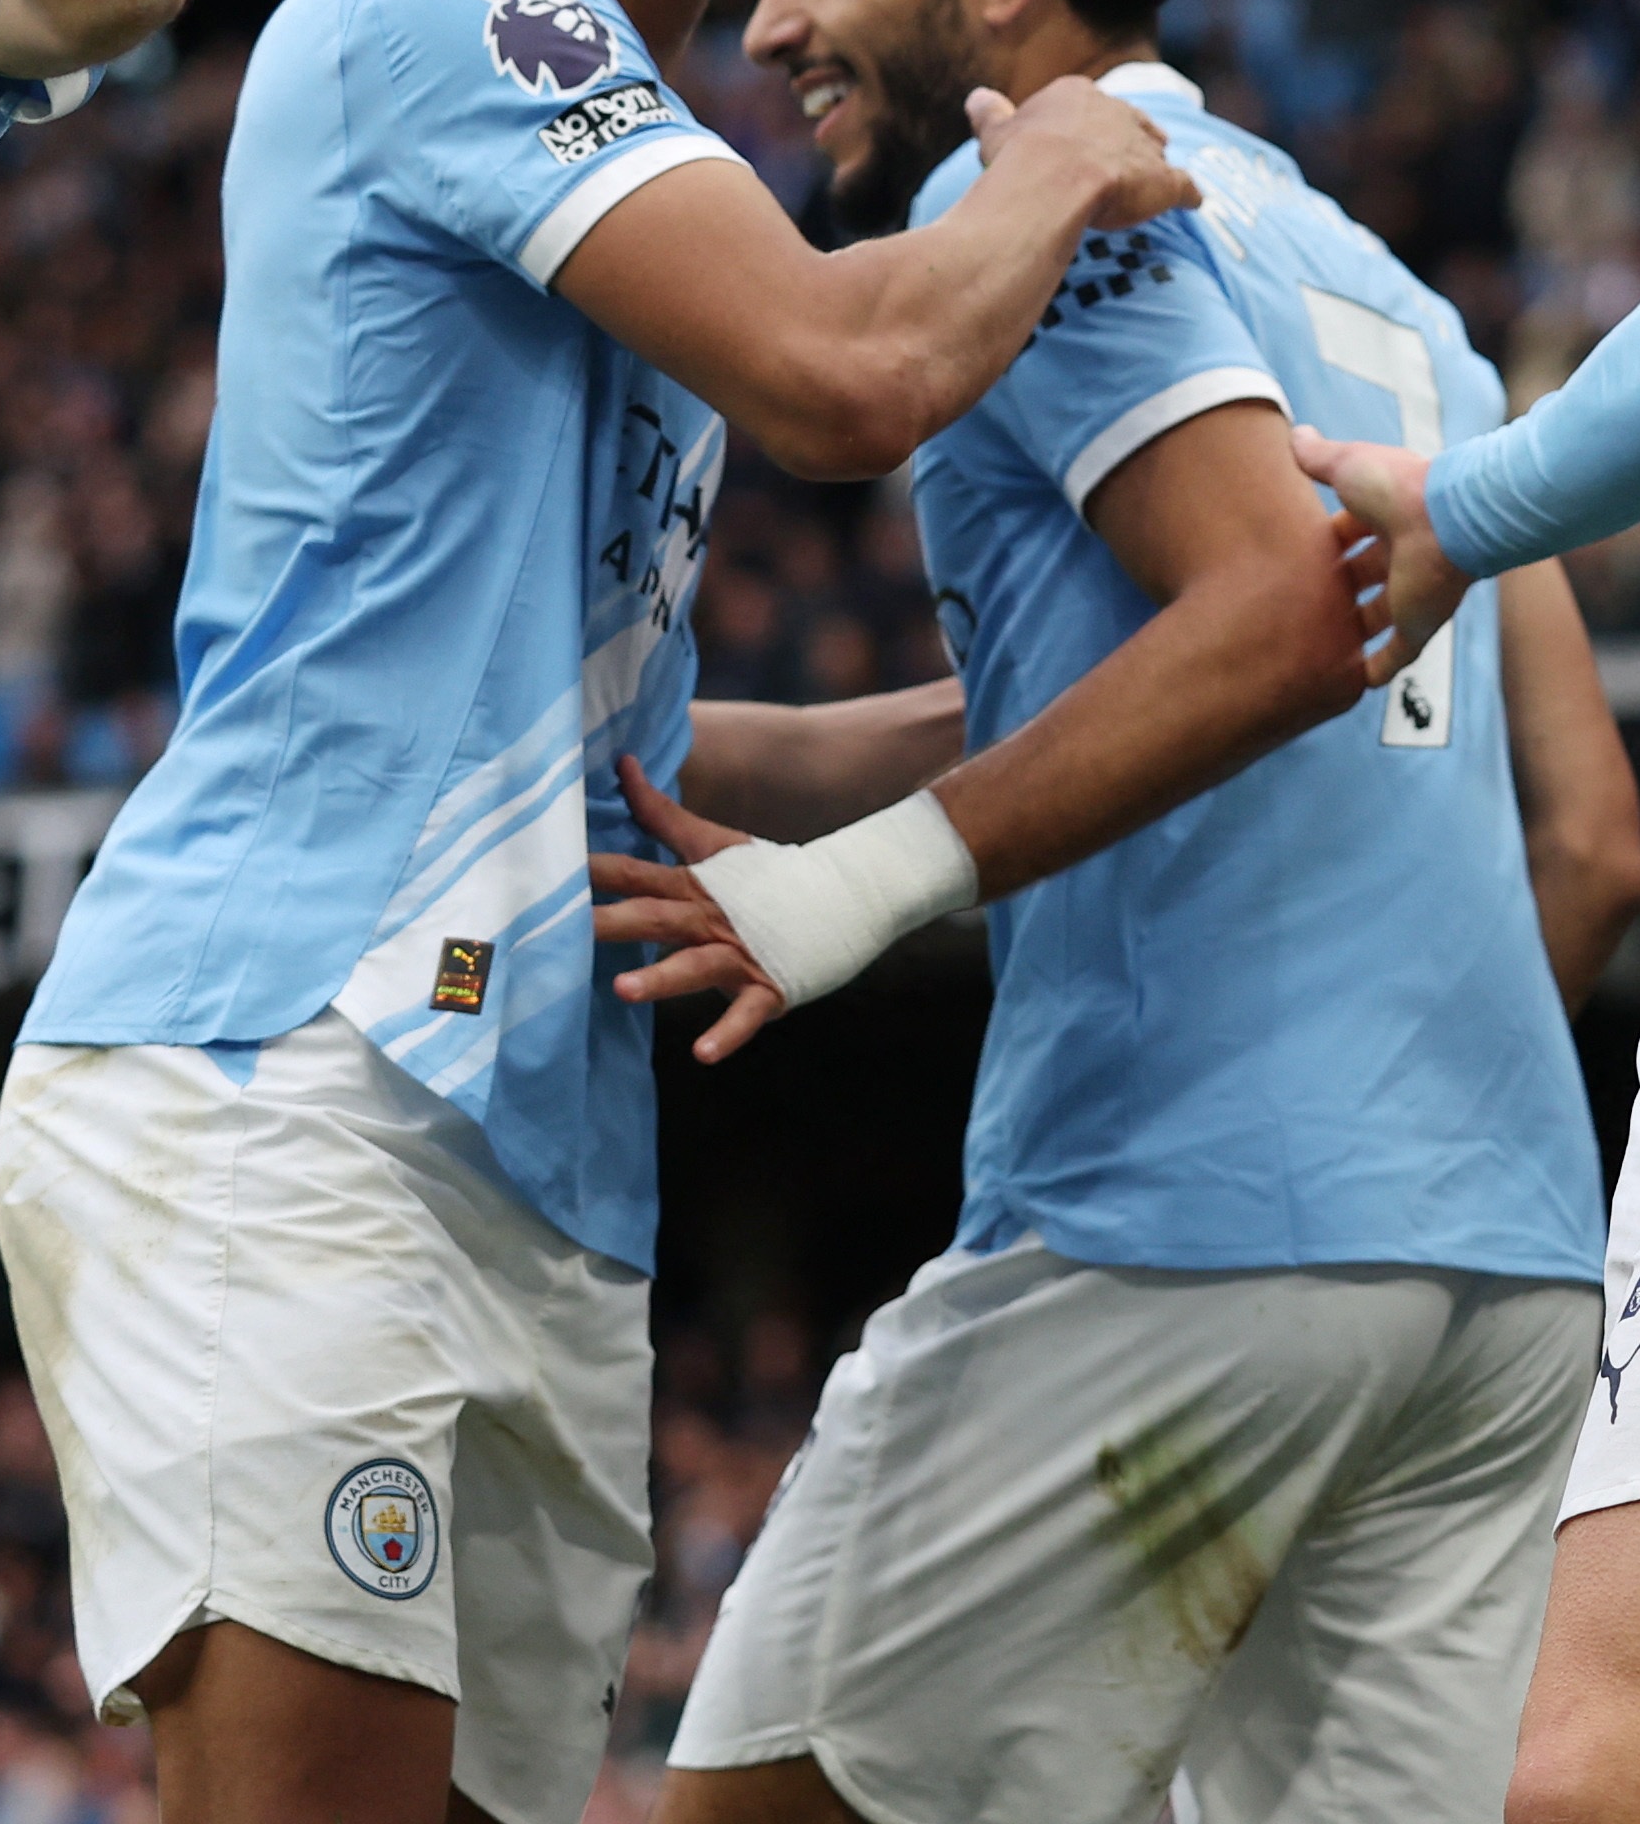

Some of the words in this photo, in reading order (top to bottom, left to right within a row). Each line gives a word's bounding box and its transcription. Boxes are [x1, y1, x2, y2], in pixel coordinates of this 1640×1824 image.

[538, 112, 589, 152] No
[340, 1469, 429, 1514] MANCHESTER
[378, 1575, 411, 1589] CITY
